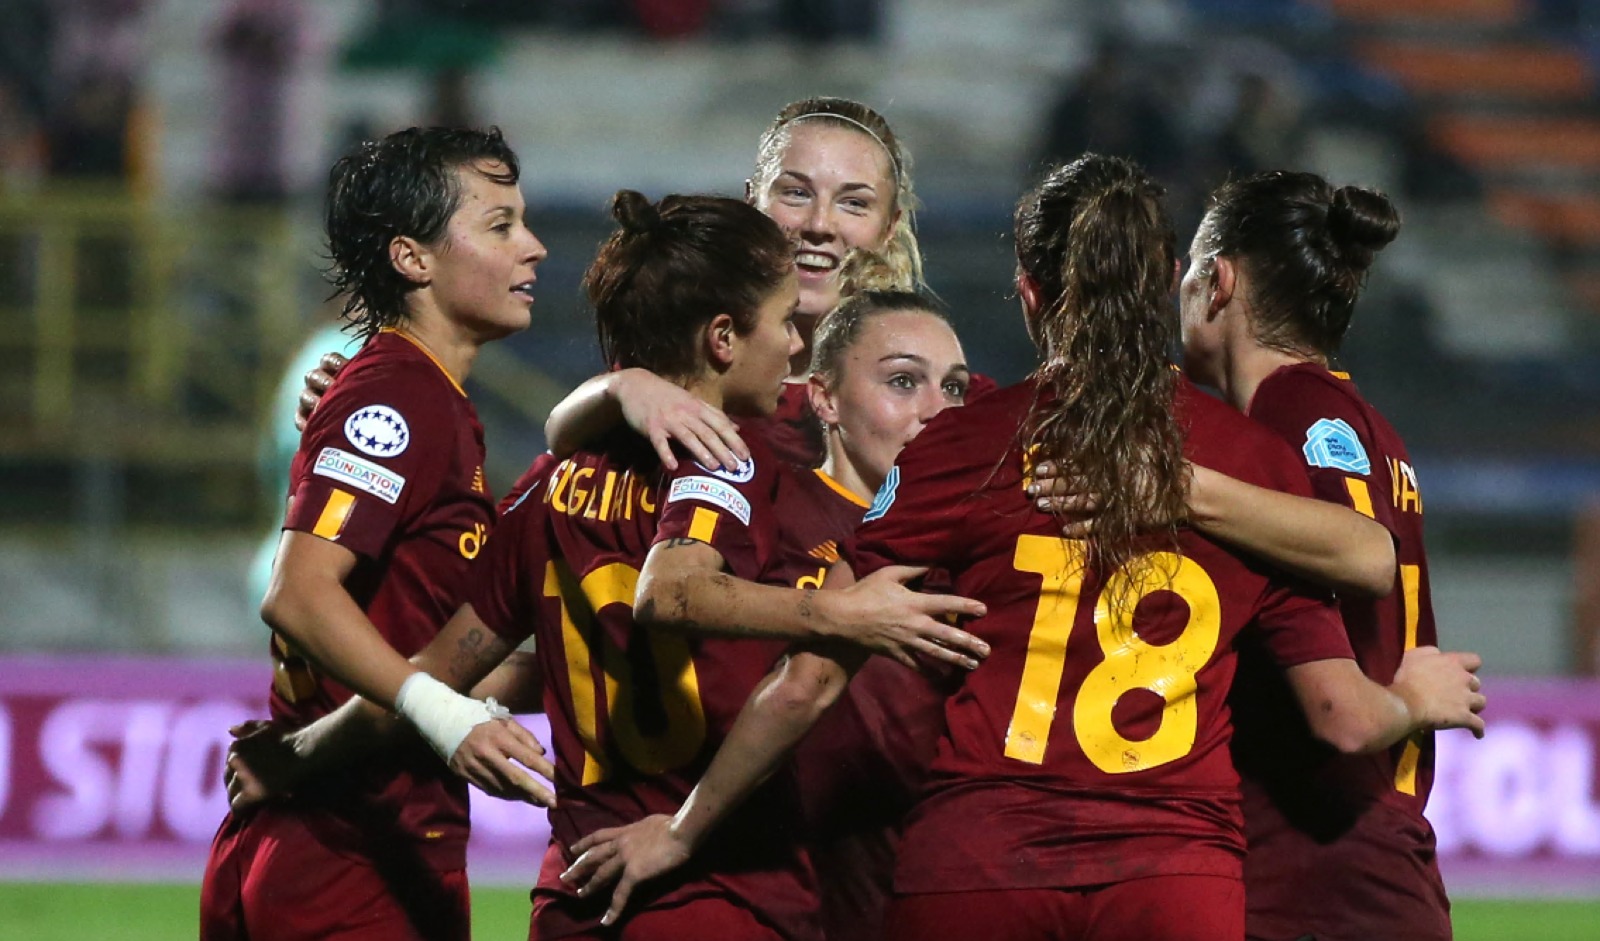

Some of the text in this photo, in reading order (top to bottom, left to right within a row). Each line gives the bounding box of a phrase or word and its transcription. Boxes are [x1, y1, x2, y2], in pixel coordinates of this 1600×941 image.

[318, 455, 400, 494] FOUNDATION
[673, 482, 749, 517] FOUNDATION
[543, 560, 706, 786] 10
[1004, 534, 1221, 774] 18
